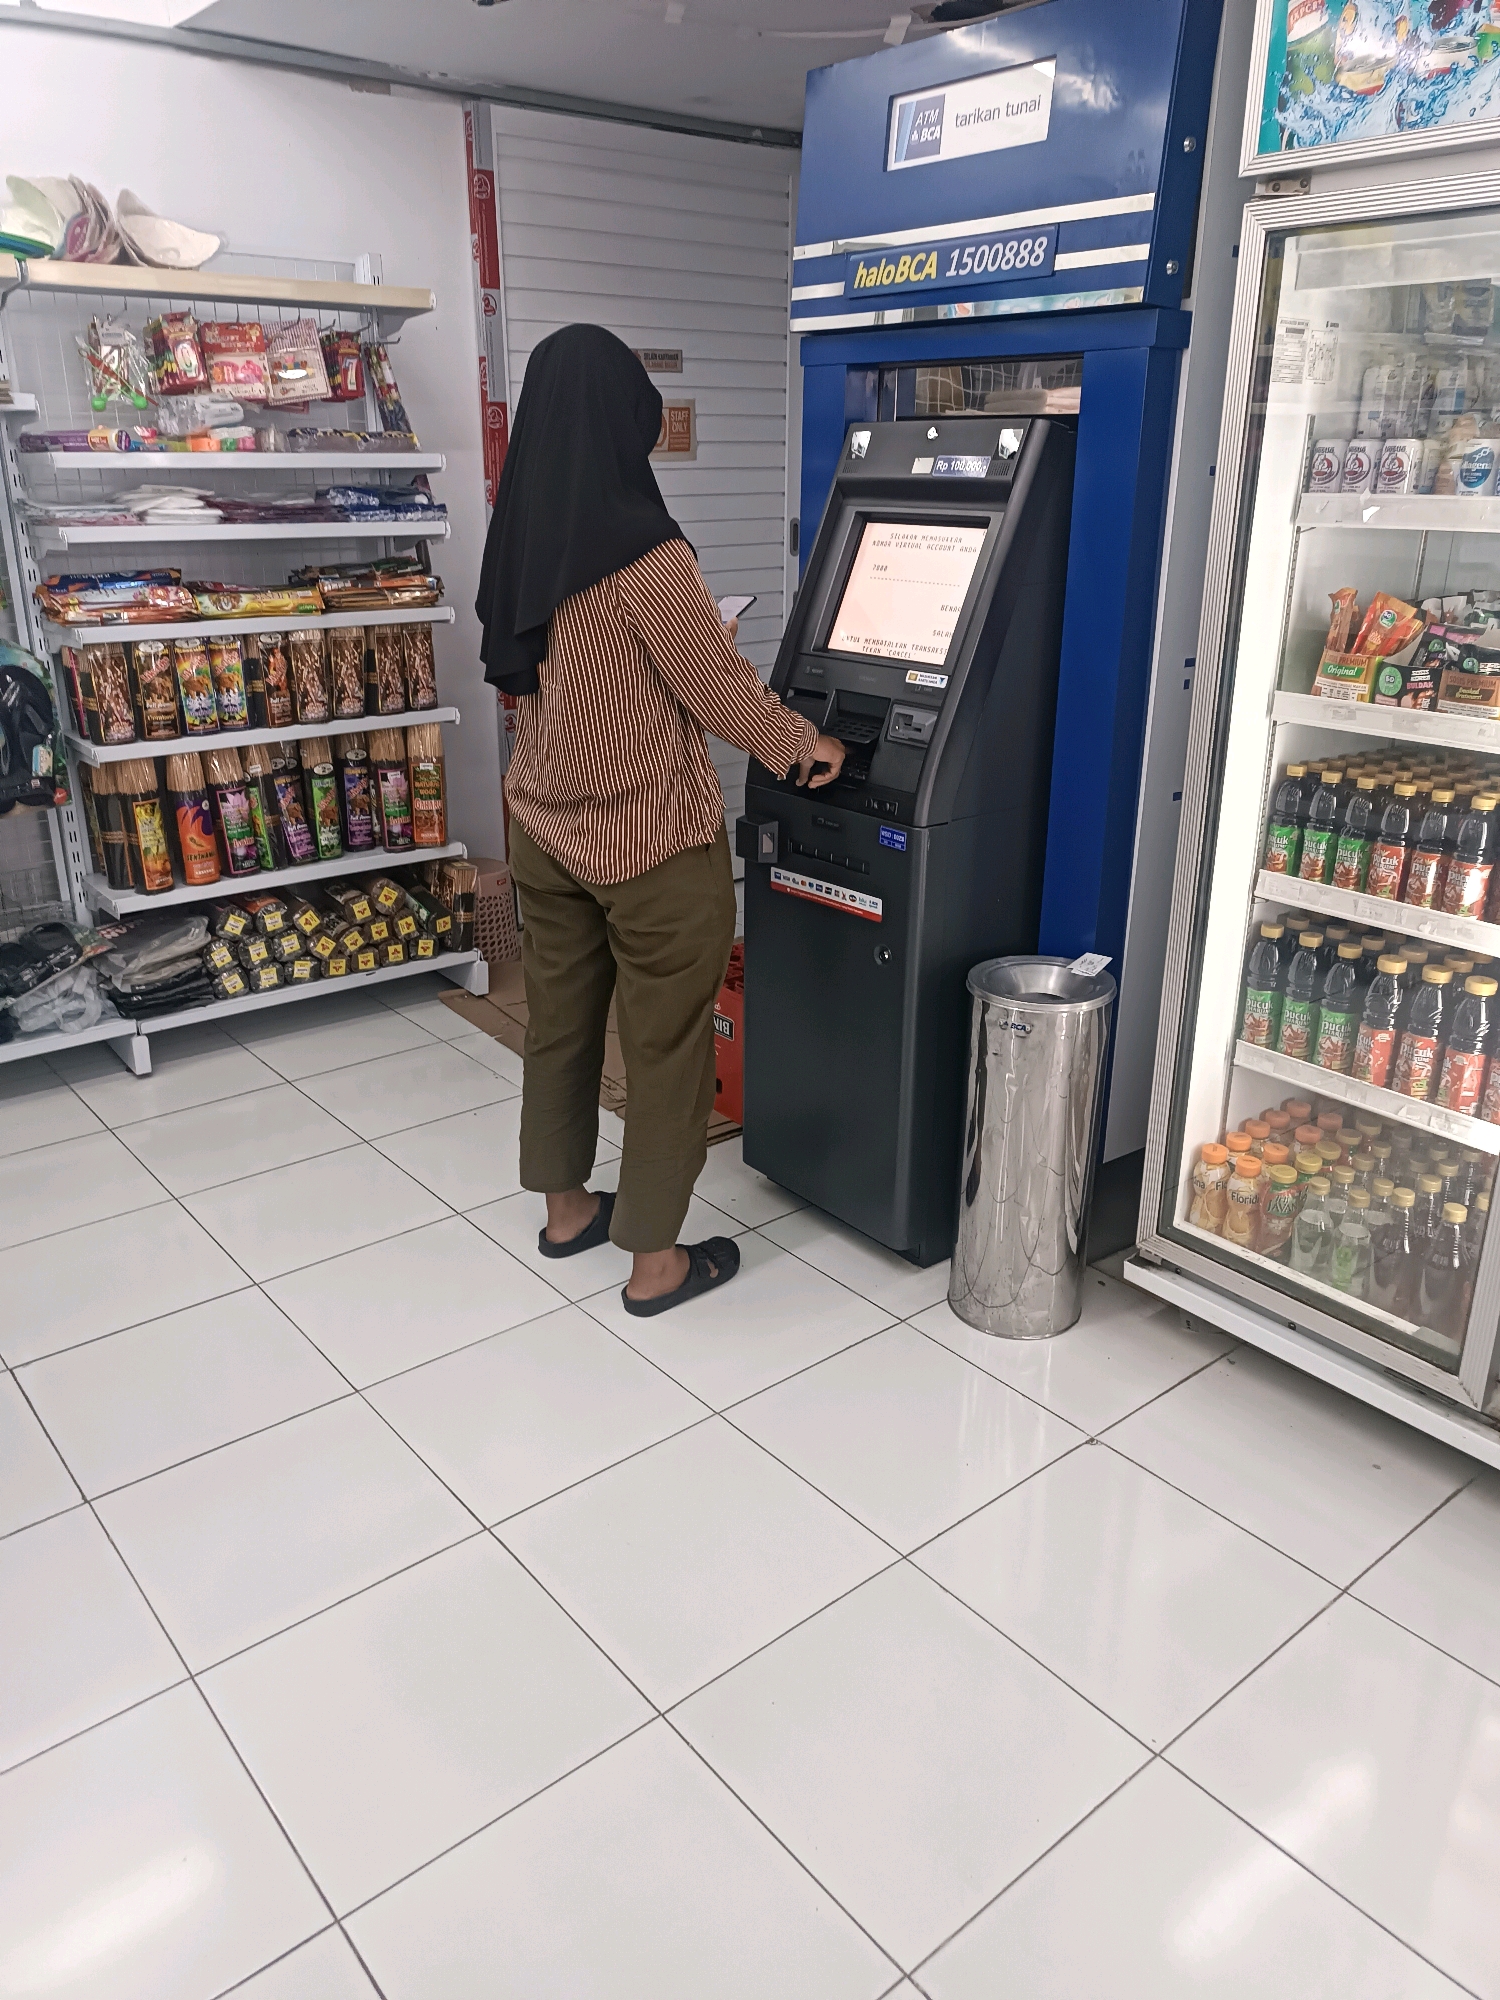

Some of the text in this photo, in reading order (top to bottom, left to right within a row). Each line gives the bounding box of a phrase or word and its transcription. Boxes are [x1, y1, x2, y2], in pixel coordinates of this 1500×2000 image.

[954, 94, 1042, 128] tarikan tunai
[914, 108, 940, 127] ATM
[919, 126, 942, 143] BCA
[853, 236, 1048, 290] haloBCA 1500888
[670, 410, 689, 421] STAFF
[671, 421, 688, 432] ONLY
[936, 460, 949, 472] Rp
[895, 541, 922, 550] VIRTUAL
[926, 543, 956, 552] ACCOUNT
[1339, 656, 1367, 667] PREMIUM
[1327, 664, 1358, 677] Original
[1406, 681, 1434, 690] BULDAK
[1372, 853, 1399, 866] pucuk
[1246, 999, 1273, 1011] pucuk
[1284, 1009, 1311, 1022] pucuk
[1010, 1022, 1027, 1032] BCA
[1400, 1042, 1434, 1059] pucuk
